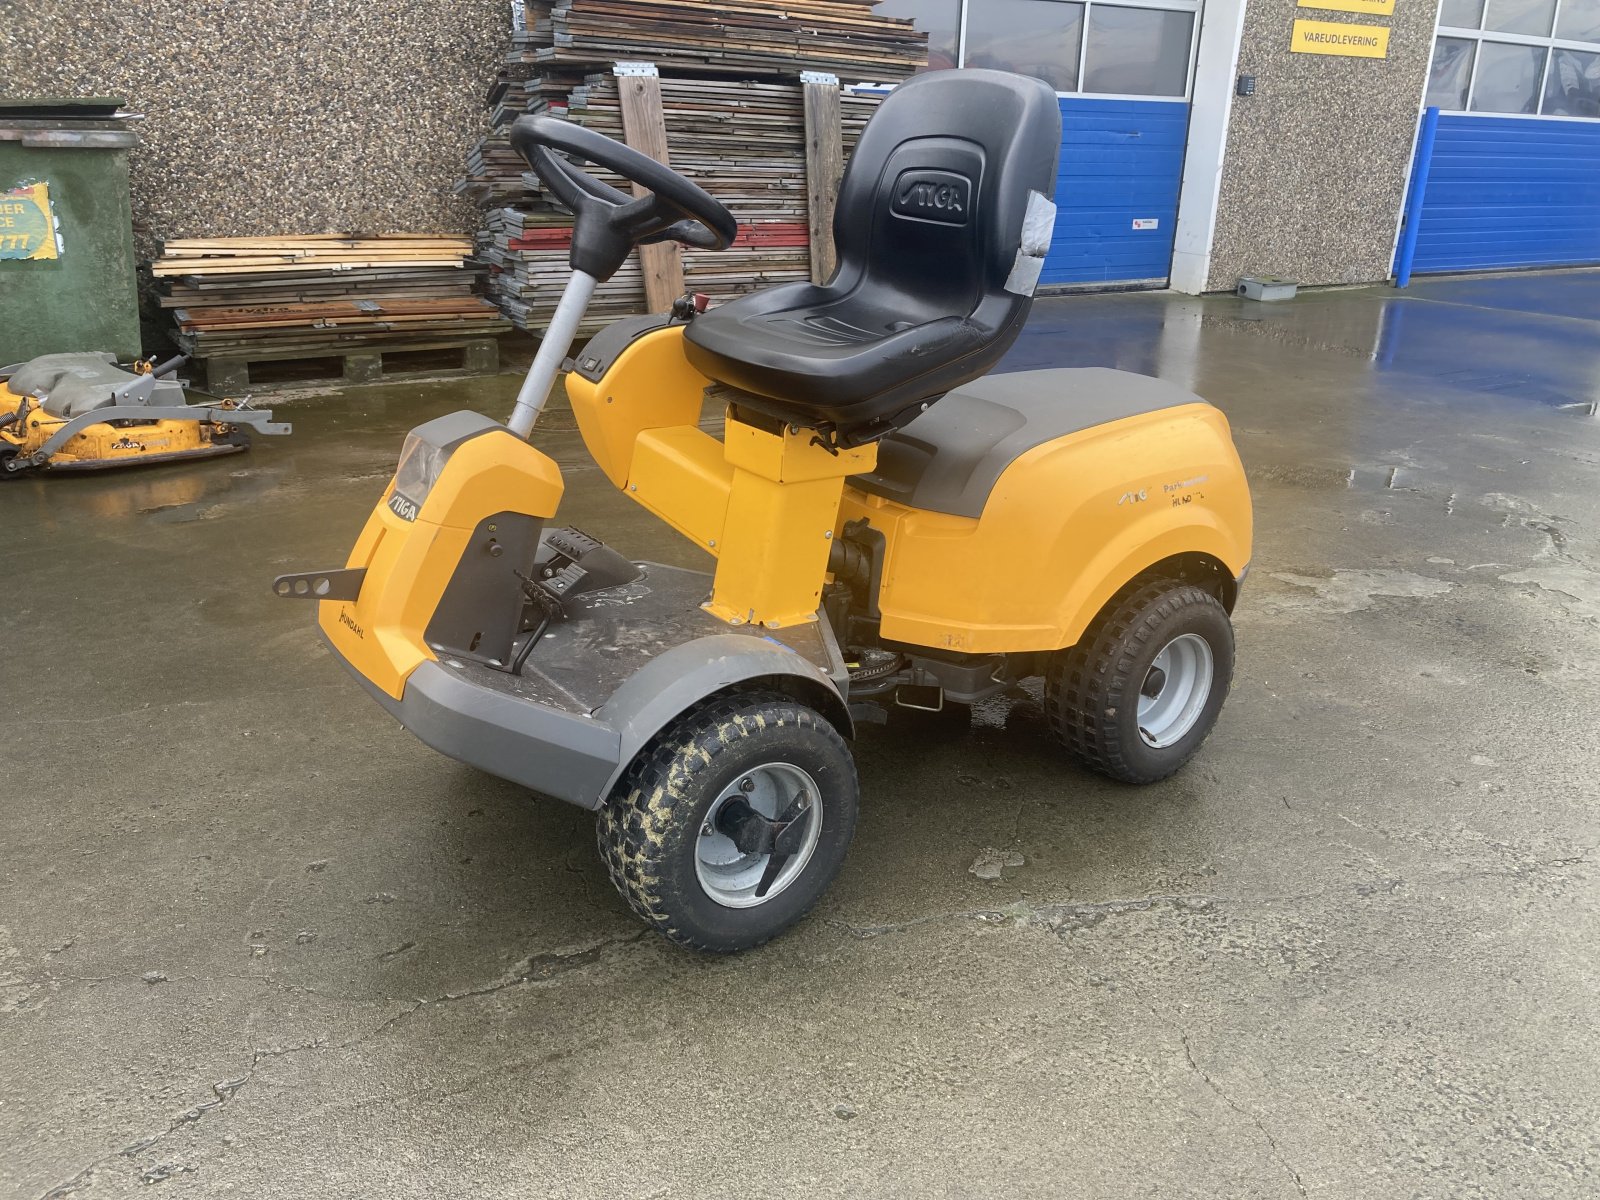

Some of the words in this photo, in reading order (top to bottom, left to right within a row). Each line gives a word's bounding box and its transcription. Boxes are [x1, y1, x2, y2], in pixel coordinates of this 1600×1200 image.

[1304, 32, 1378, 47] VAREUDLEVERING
[900, 181, 963, 212] STIGA
[0, 203, 24, 214] ER
[389, 495, 416, 522] STIGA
